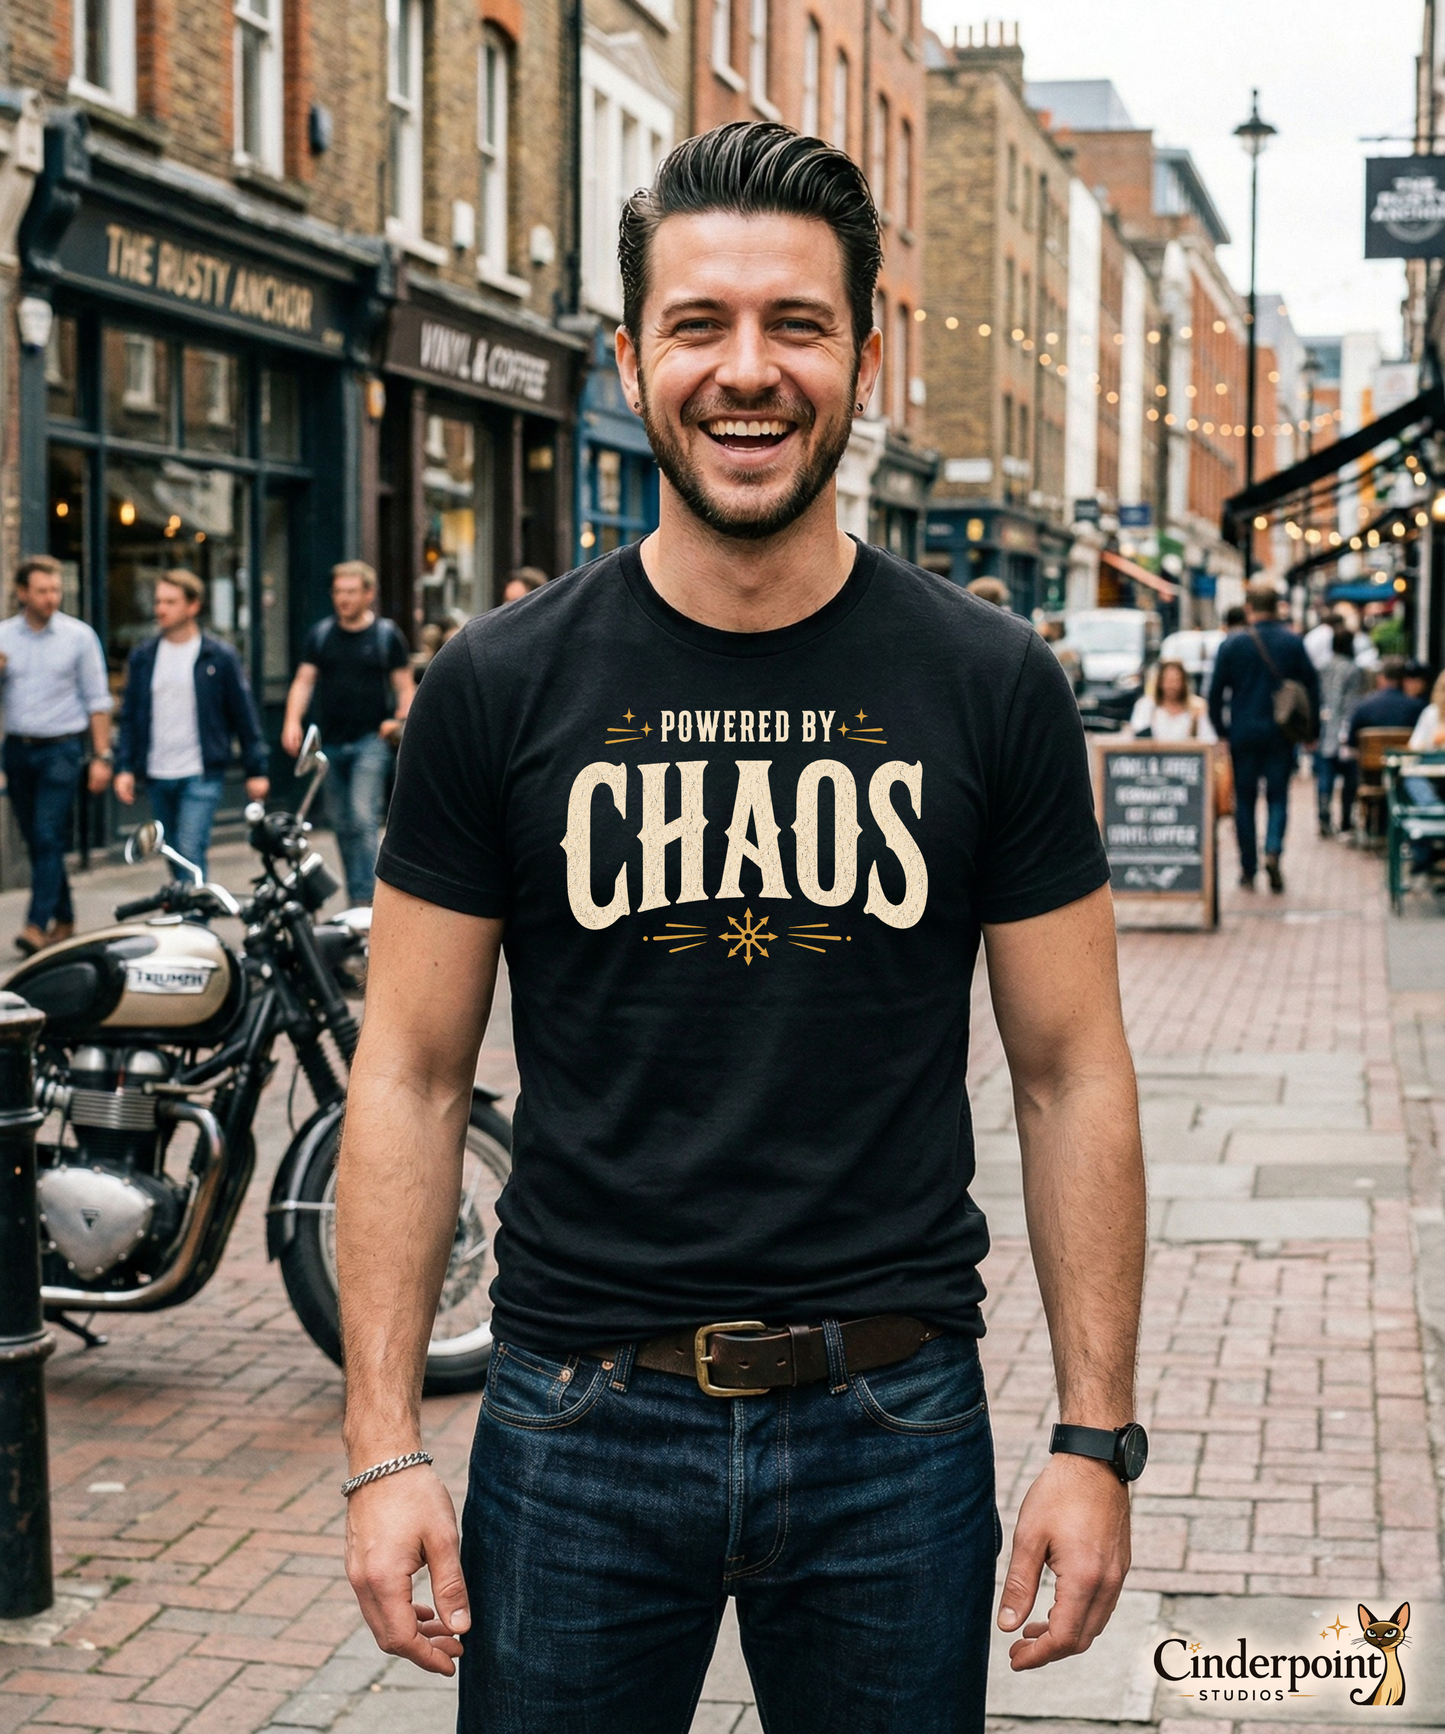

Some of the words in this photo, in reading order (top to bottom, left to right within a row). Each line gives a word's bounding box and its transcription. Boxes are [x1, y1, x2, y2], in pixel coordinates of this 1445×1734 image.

[106, 223, 155, 286] THE
[156, 241, 231, 308] RUSTY
[230, 267, 313, 331] ANCHOR
[420, 320, 471, 380] VINYL
[472, 338, 488, 383] &
[487, 345, 549, 401] COFFEE
[660, 710, 790, 742] POWERED
[801, 710, 836, 742] BY
[559, 759, 929, 930] CHAOS
[137, 971, 203, 986] TRIUMPH
